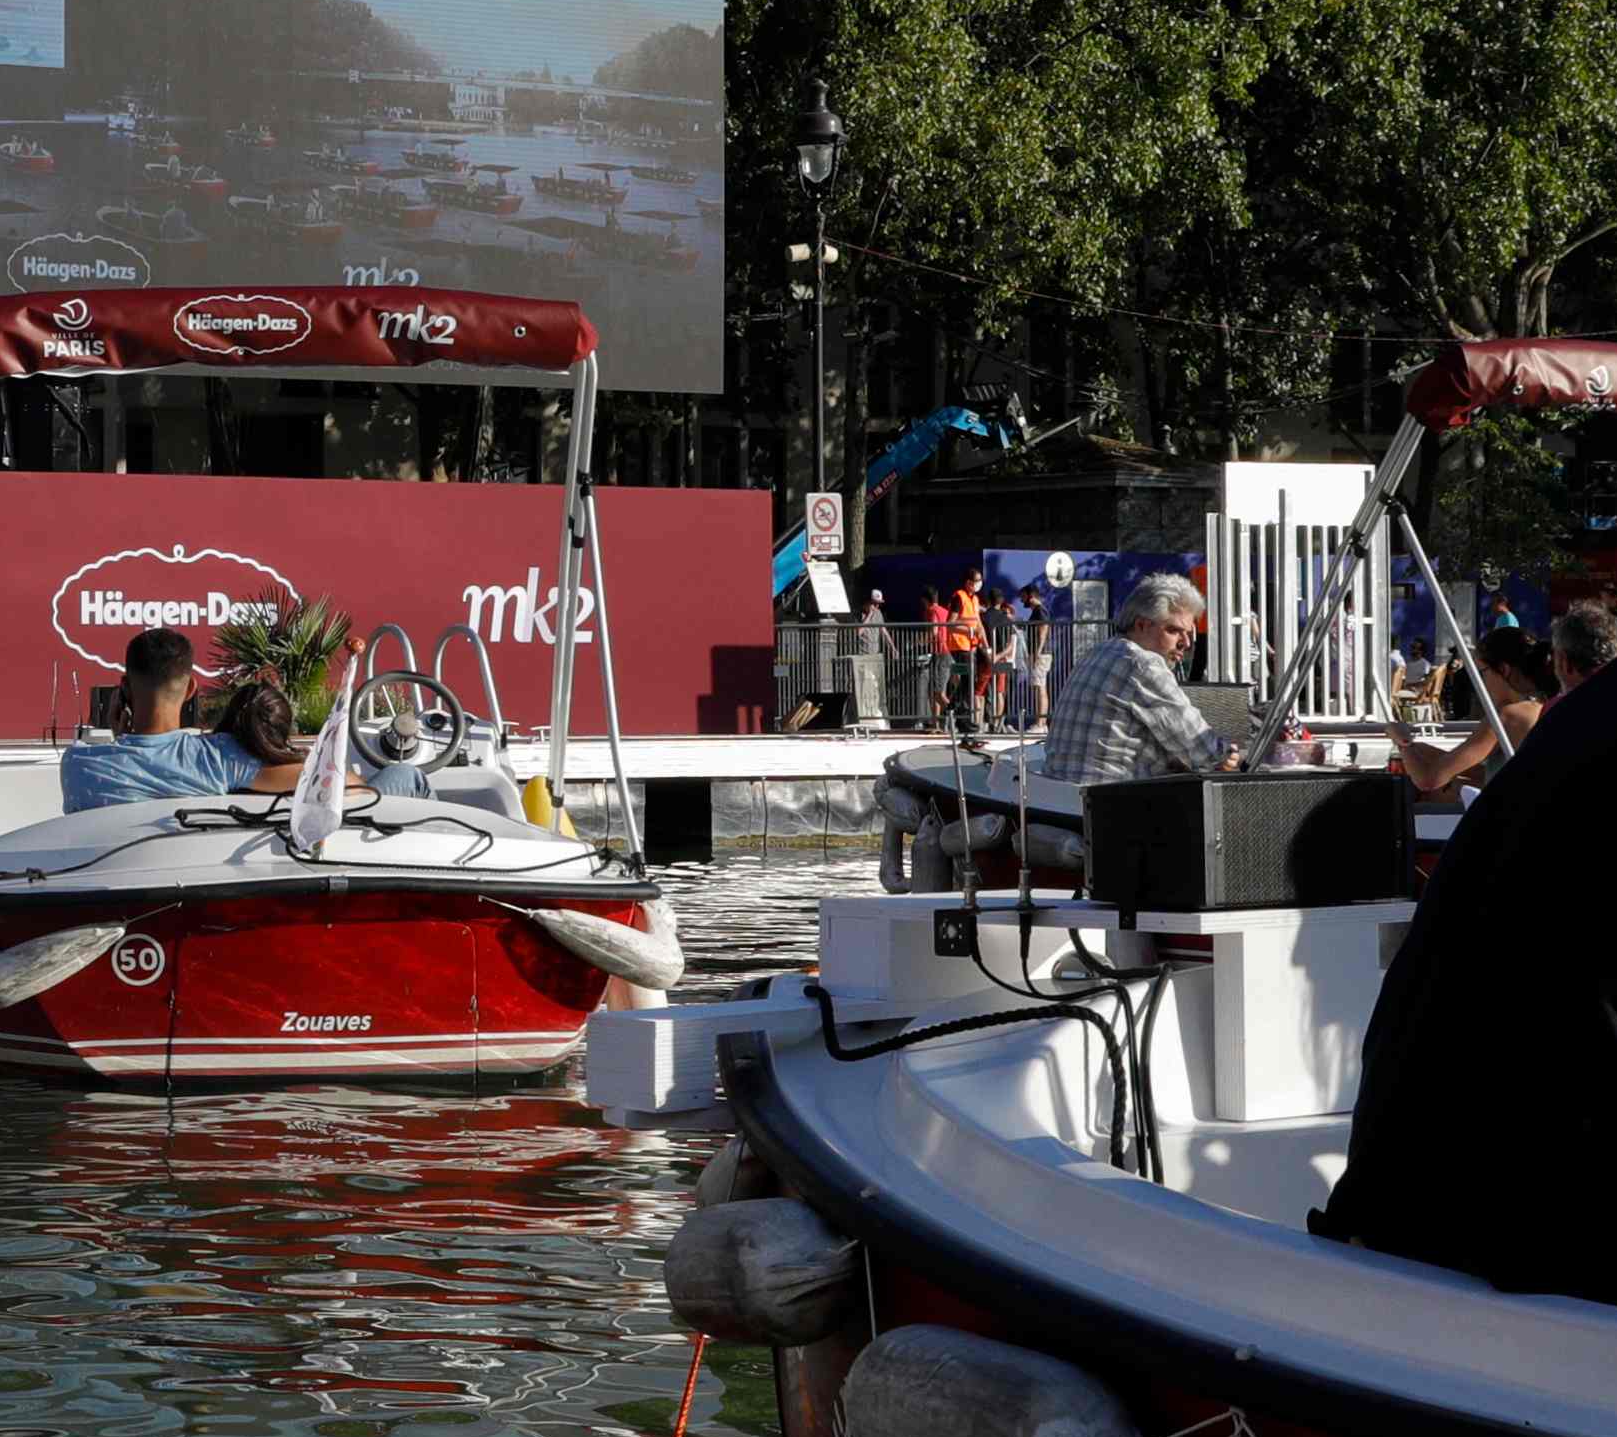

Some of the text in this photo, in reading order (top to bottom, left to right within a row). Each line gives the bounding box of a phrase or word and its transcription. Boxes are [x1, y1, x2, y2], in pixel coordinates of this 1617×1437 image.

[22, 255, 137, 282] Häagen-Dazs
[187, 313, 298, 334] Häagen-Dazs
[377, 304, 457, 346] mk2
[43, 339, 105, 358] PARIS
[462, 566, 595, 644] mk2
[119, 947, 159, 972] 50
[280, 1011, 372, 1032] Zouaves
